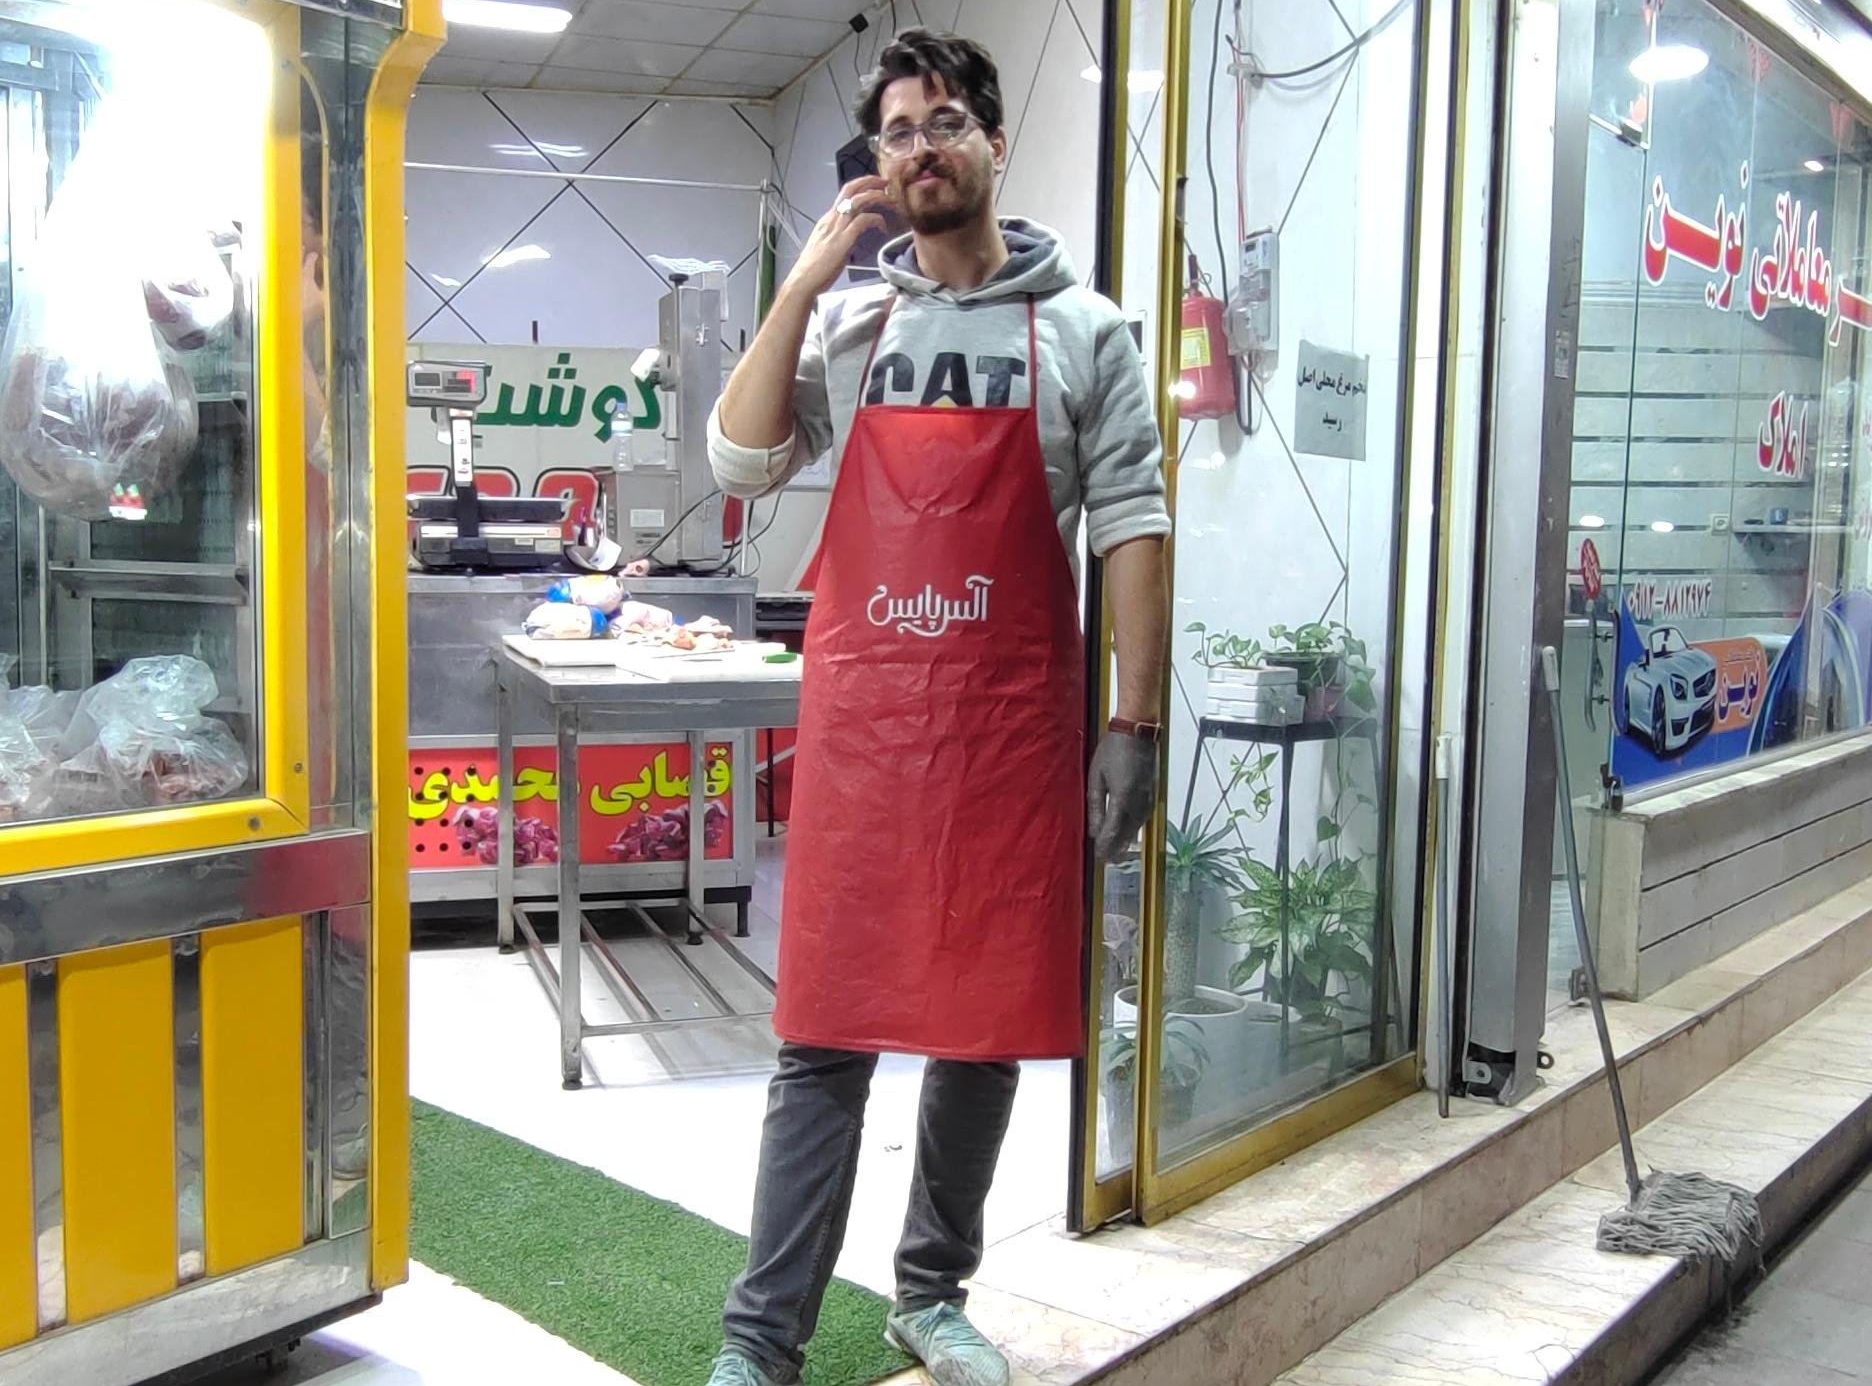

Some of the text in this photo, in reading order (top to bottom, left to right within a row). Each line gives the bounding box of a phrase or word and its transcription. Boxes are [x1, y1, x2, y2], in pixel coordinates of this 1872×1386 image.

[1644, 160, 1750, 312] نوین
[1749, 190, 1831, 321] معاملاتی
[866, 352, 1026, 408] CAT
[1757, 390, 1809, 479] املاک
[1714, 650, 1762, 724] نوین
